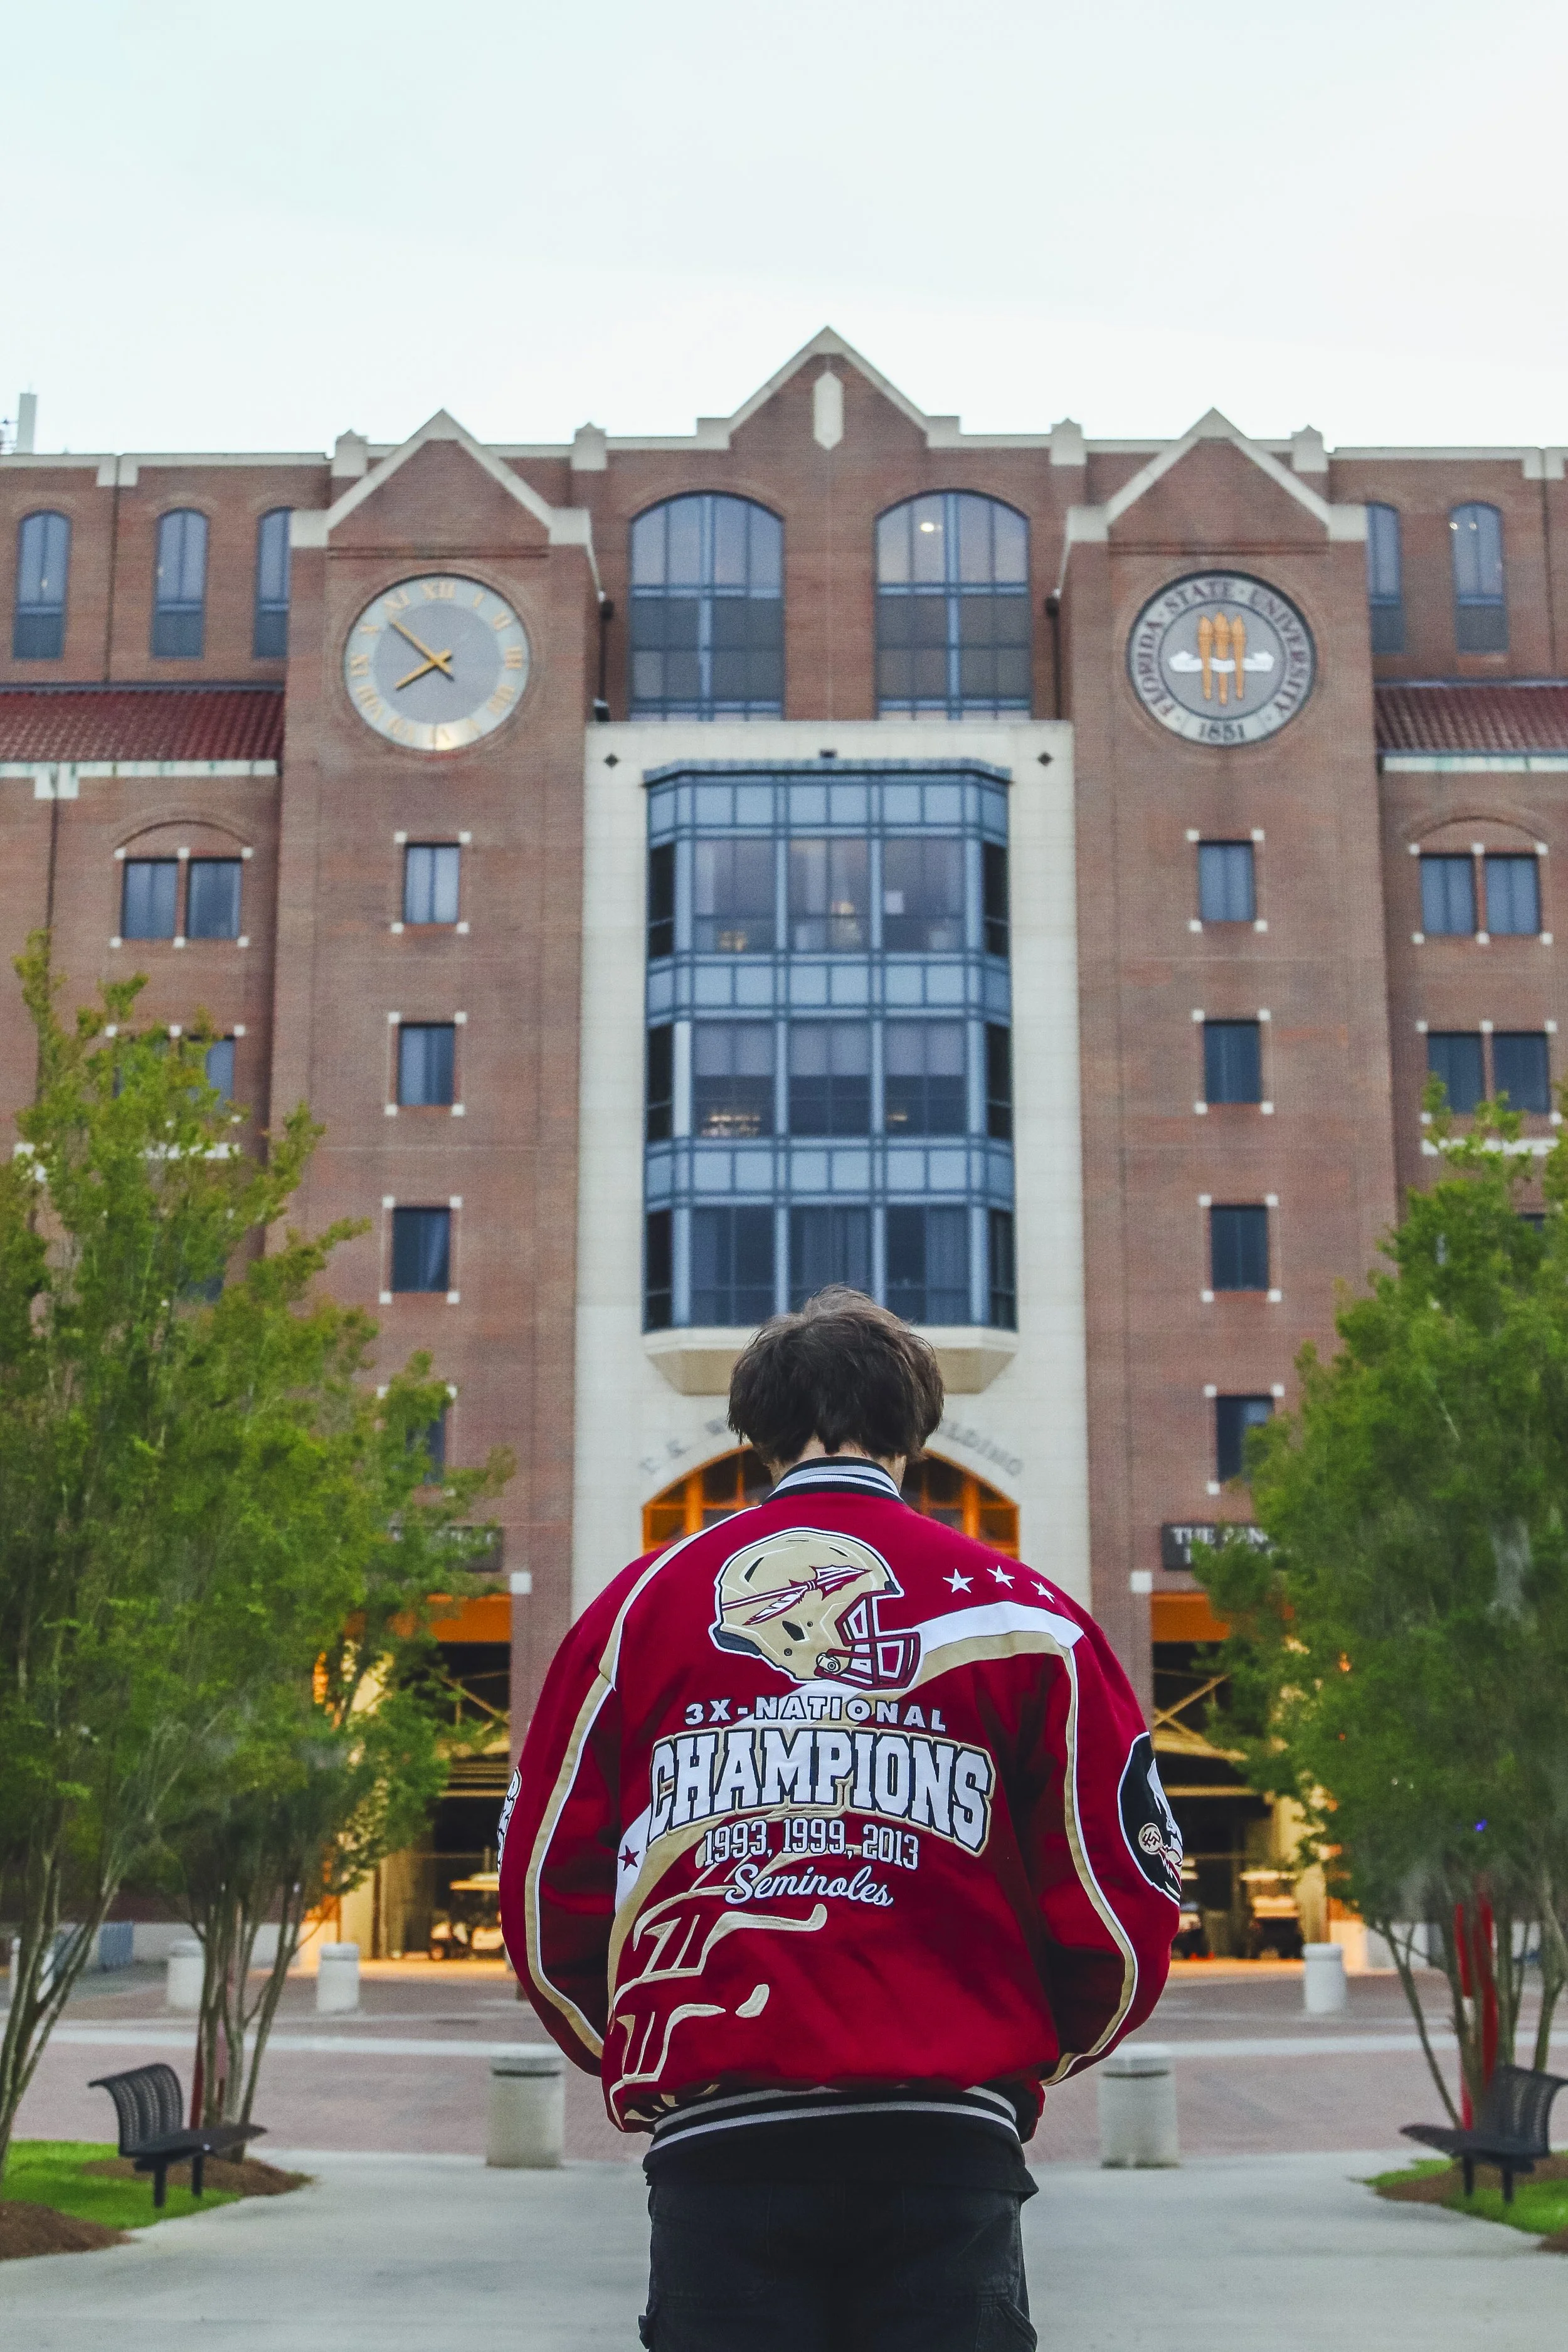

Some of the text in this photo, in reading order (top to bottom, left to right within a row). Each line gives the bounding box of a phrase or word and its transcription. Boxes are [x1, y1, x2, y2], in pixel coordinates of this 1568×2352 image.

[420, 581, 455, 600] XII
[505, 646, 523, 670] III
[1138, 581, 1306, 716] FLORIDA STATE UNIVERSITY
[1199, 721, 1246, 741] 1851
[684, 1695, 946, 1732] 3X-NATIONAL
[648, 1726, 994, 1855] CHAMPIONS
[704, 1818, 920, 1871] 1993, 1999, 2013
[1142, 1830, 1161, 1848] FSU
[724, 1863, 894, 1907] Seminoles
